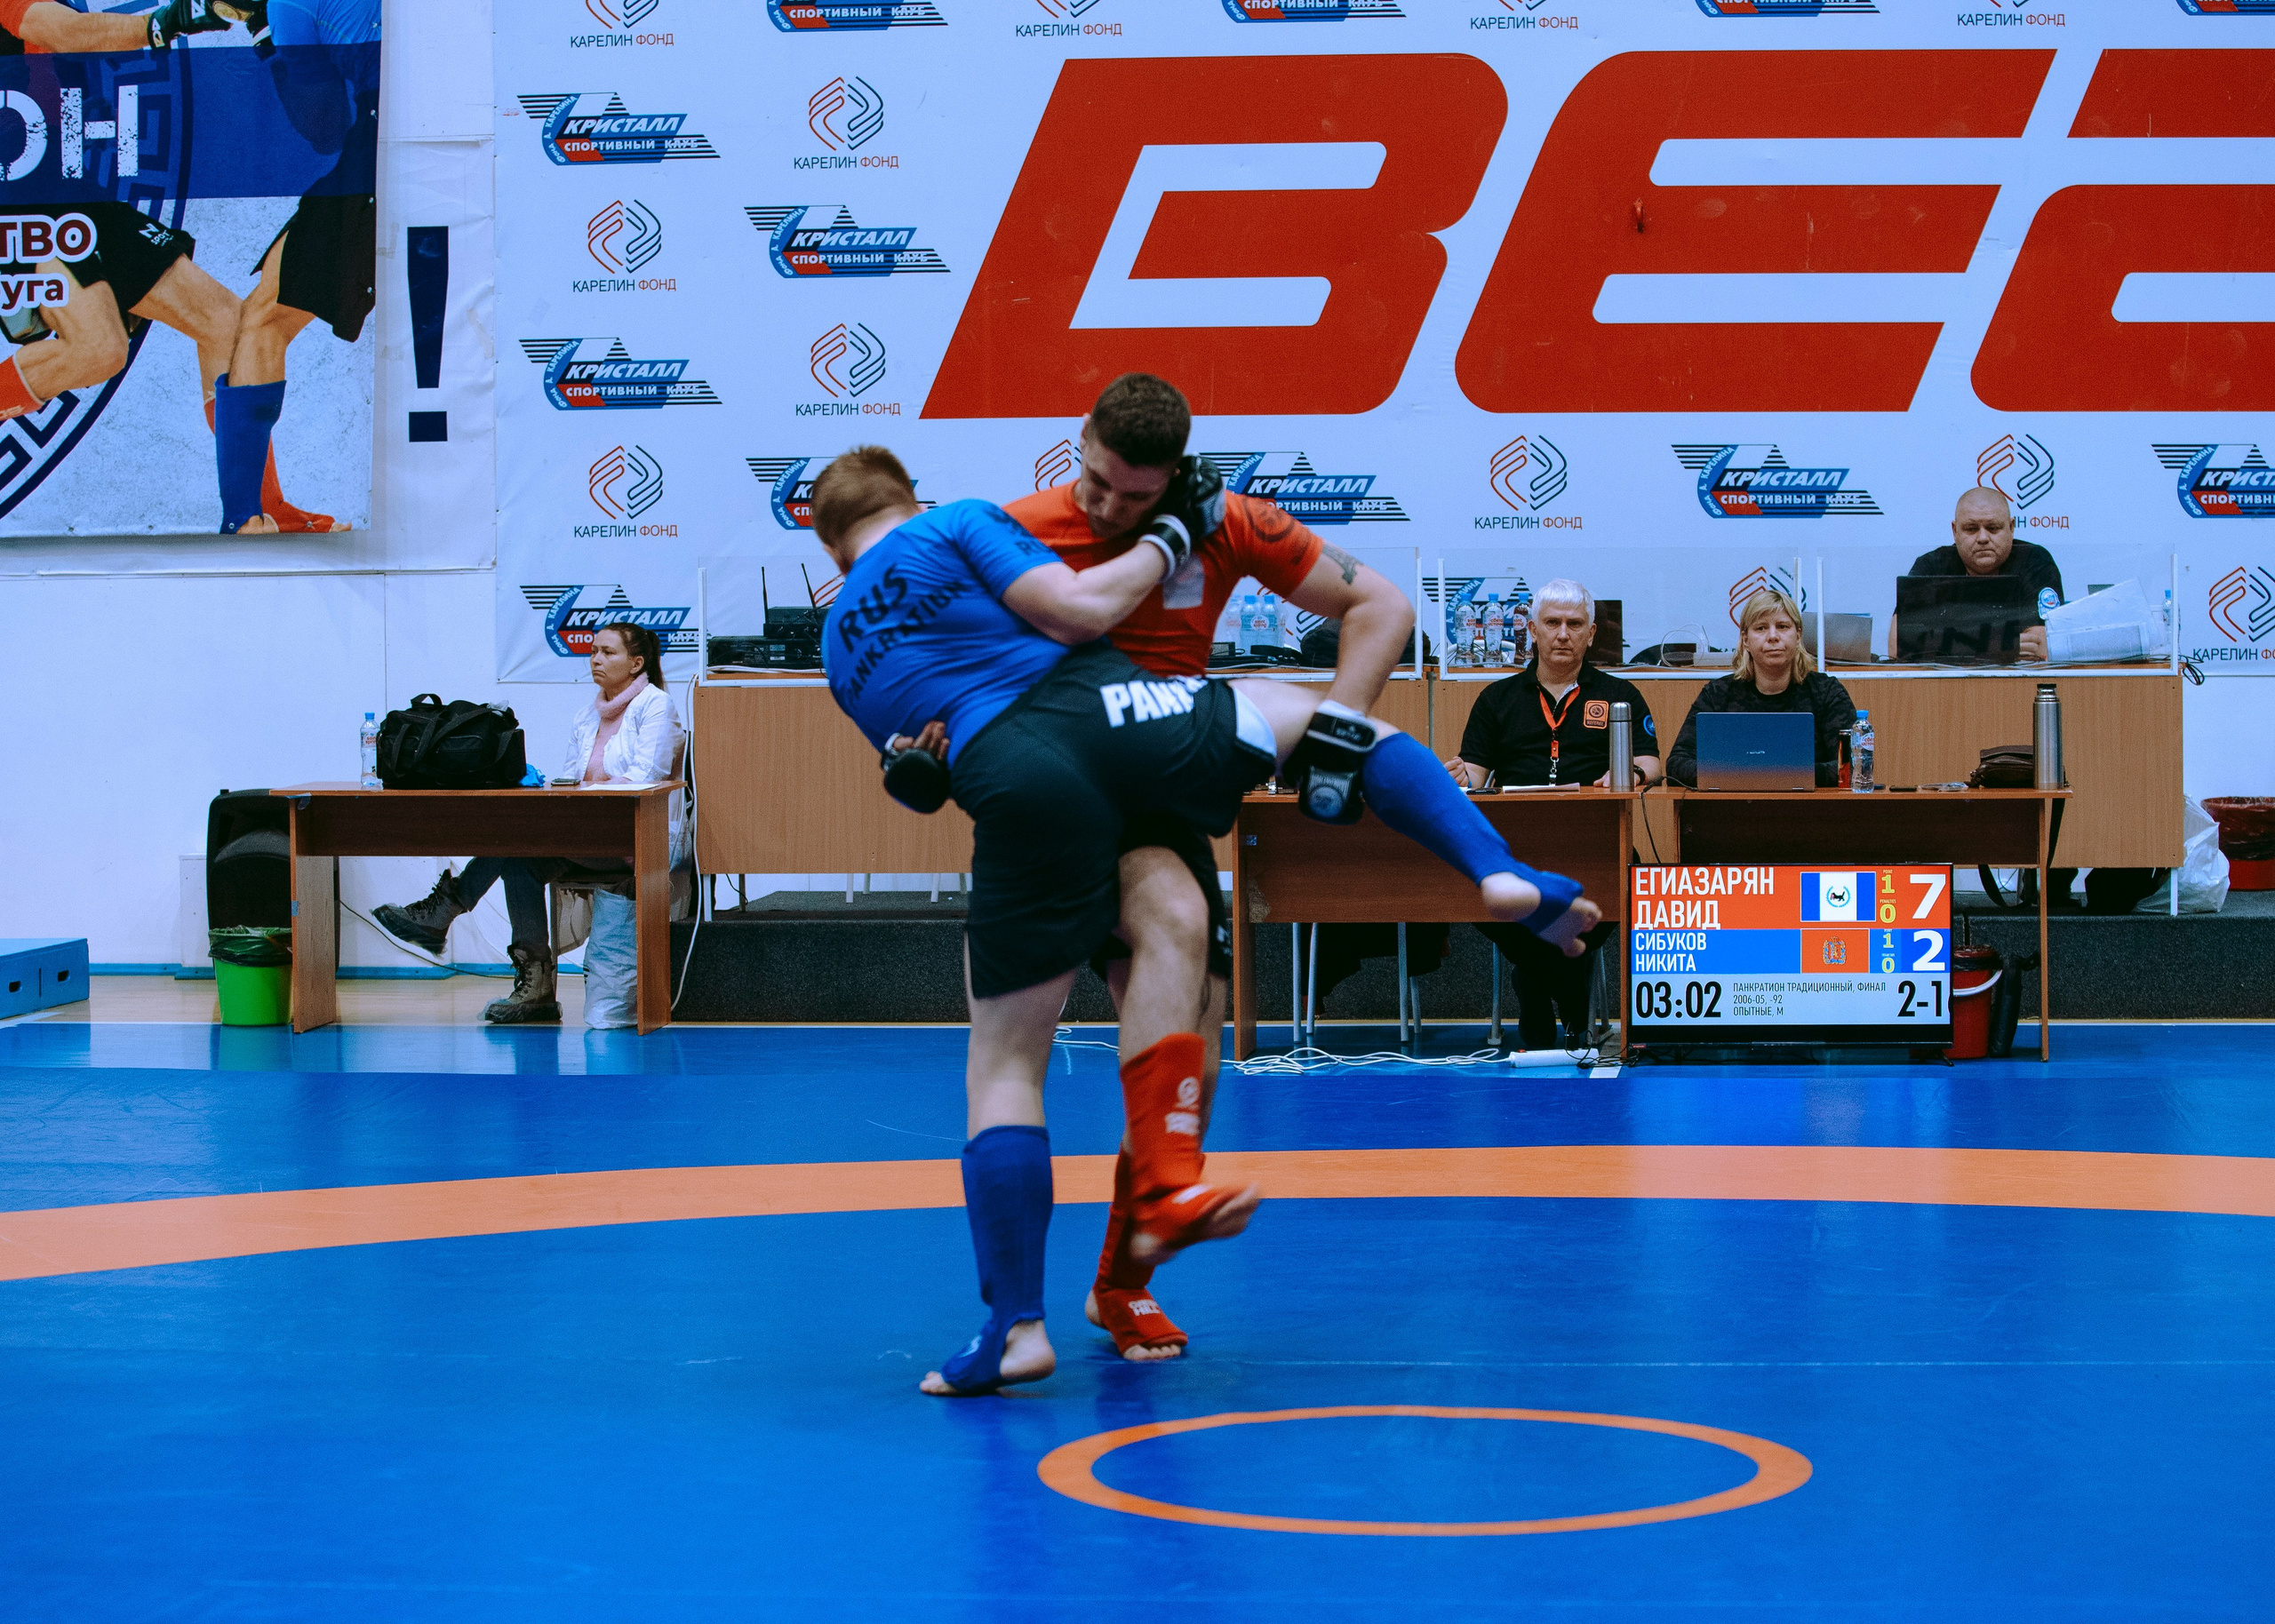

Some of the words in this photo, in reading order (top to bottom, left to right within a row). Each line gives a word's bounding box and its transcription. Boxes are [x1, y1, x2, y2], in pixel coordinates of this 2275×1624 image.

[789, 7, 882, 19] СПОРТИВНЫЙ
[1957, 13, 2024, 28] КАРЕЛИН
[2025, 12, 2065, 27] ФОНД
[1016, 24, 1080, 36] КАРЕЛИН
[1083, 23, 1122, 36] ФОНД
[1469, 16, 1537, 30] КАРЕЛИН
[1539, 15, 1578, 29] ФОНД
[571, 35, 633, 48] КАРЕЛИН
[635, 33, 675, 46] ФОНД
[545, 96, 578, 127] КАРЕЛИНА
[564, 117, 681, 134] КРИСТАЛЛ
[564, 139, 655, 151] СПОРТИВНЫЙ
[794, 156, 857, 169] КАРЕЛИН
[860, 155, 898, 169] ФОНД
[772, 208, 805, 240] КАРЕЛИНА
[792, 229, 909, 247] КРИСТАЛЛ
[792, 252, 883, 264] СПОРТИВНЫЙ
[572, 280, 635, 292] КАРЕЛИН
[638, 279, 676, 291] ФОНД
[547, 339, 579, 372] КАРЕЛИНА
[566, 362, 684, 380] КРИСТАЛЛ
[566, 385, 658, 397] СПОРТИВНЫЙ
[795, 403, 858, 416] КАРЕЛИН
[862, 402, 901, 416] ФОНД
[1701, 447, 1735, 479] КАРЕЛИНА
[2181, 446, 2215, 479] КАРЕЛИНА
[774, 459, 807, 491] КАРЕЛИНА
[1229, 455, 1261, 487] КАРЕЛИНА
[1720, 471, 1842, 487] КРИСТАЛЛ
[2199, 471, 2275, 487] КРИСТ
[1248, 478, 1369, 494] КРИСТАЛЛ
[1268, 500, 1342, 511] РТИВНЫЙ
[1720, 493, 1816, 505] СПОРТИВНЫЙ
[574, 525, 636, 537] КАРЕЛИН
[640, 524, 678, 537] ФОНД
[1475, 517, 1539, 529] КАРЕЛИН
[1543, 516, 1582, 529] ФОНД
[2030, 516, 2069, 529] ФОНД
[547, 587, 580, 619] КАРЕЛИНА
[839, 562, 907, 655] RUS
[566, 610, 683, 626] КРИСТАЛЛ
[2193, 649, 2258, 661] КАРЕЛИН
[1635, 867, 1775, 896] ЕГИАЗАРЯН
[1881, 874, 1895, 894] 1
[1910, 874, 1946, 919] 7
[1634, 900, 1721, 930] ДАВИД
[1880, 904, 1896, 923] 0
[1635, 933, 1707, 951] СИБУКОВ
[1883, 933, 1894, 948] 1
[1912, 930, 1945, 971] 2
[1635, 953, 1696, 972] НИКИТА
[1881, 958, 1895, 974] 0
[1733, 983, 1784, 992] ПАНКРАТИОН
[1787, 981, 1855, 993] ТРАДИЦИОННЫЙ,
[1857, 983, 1886, 991] ФИНАЛ
[1635, 981, 1722, 1018] 03:02
[1733, 995, 1768, 1005] 2006-05,
[1769, 995, 1783, 1004] -92
[1733, 1007, 1774, 1017] ОПЫТНЫЕ,
[1776, 1007, 1784, 1016] М
